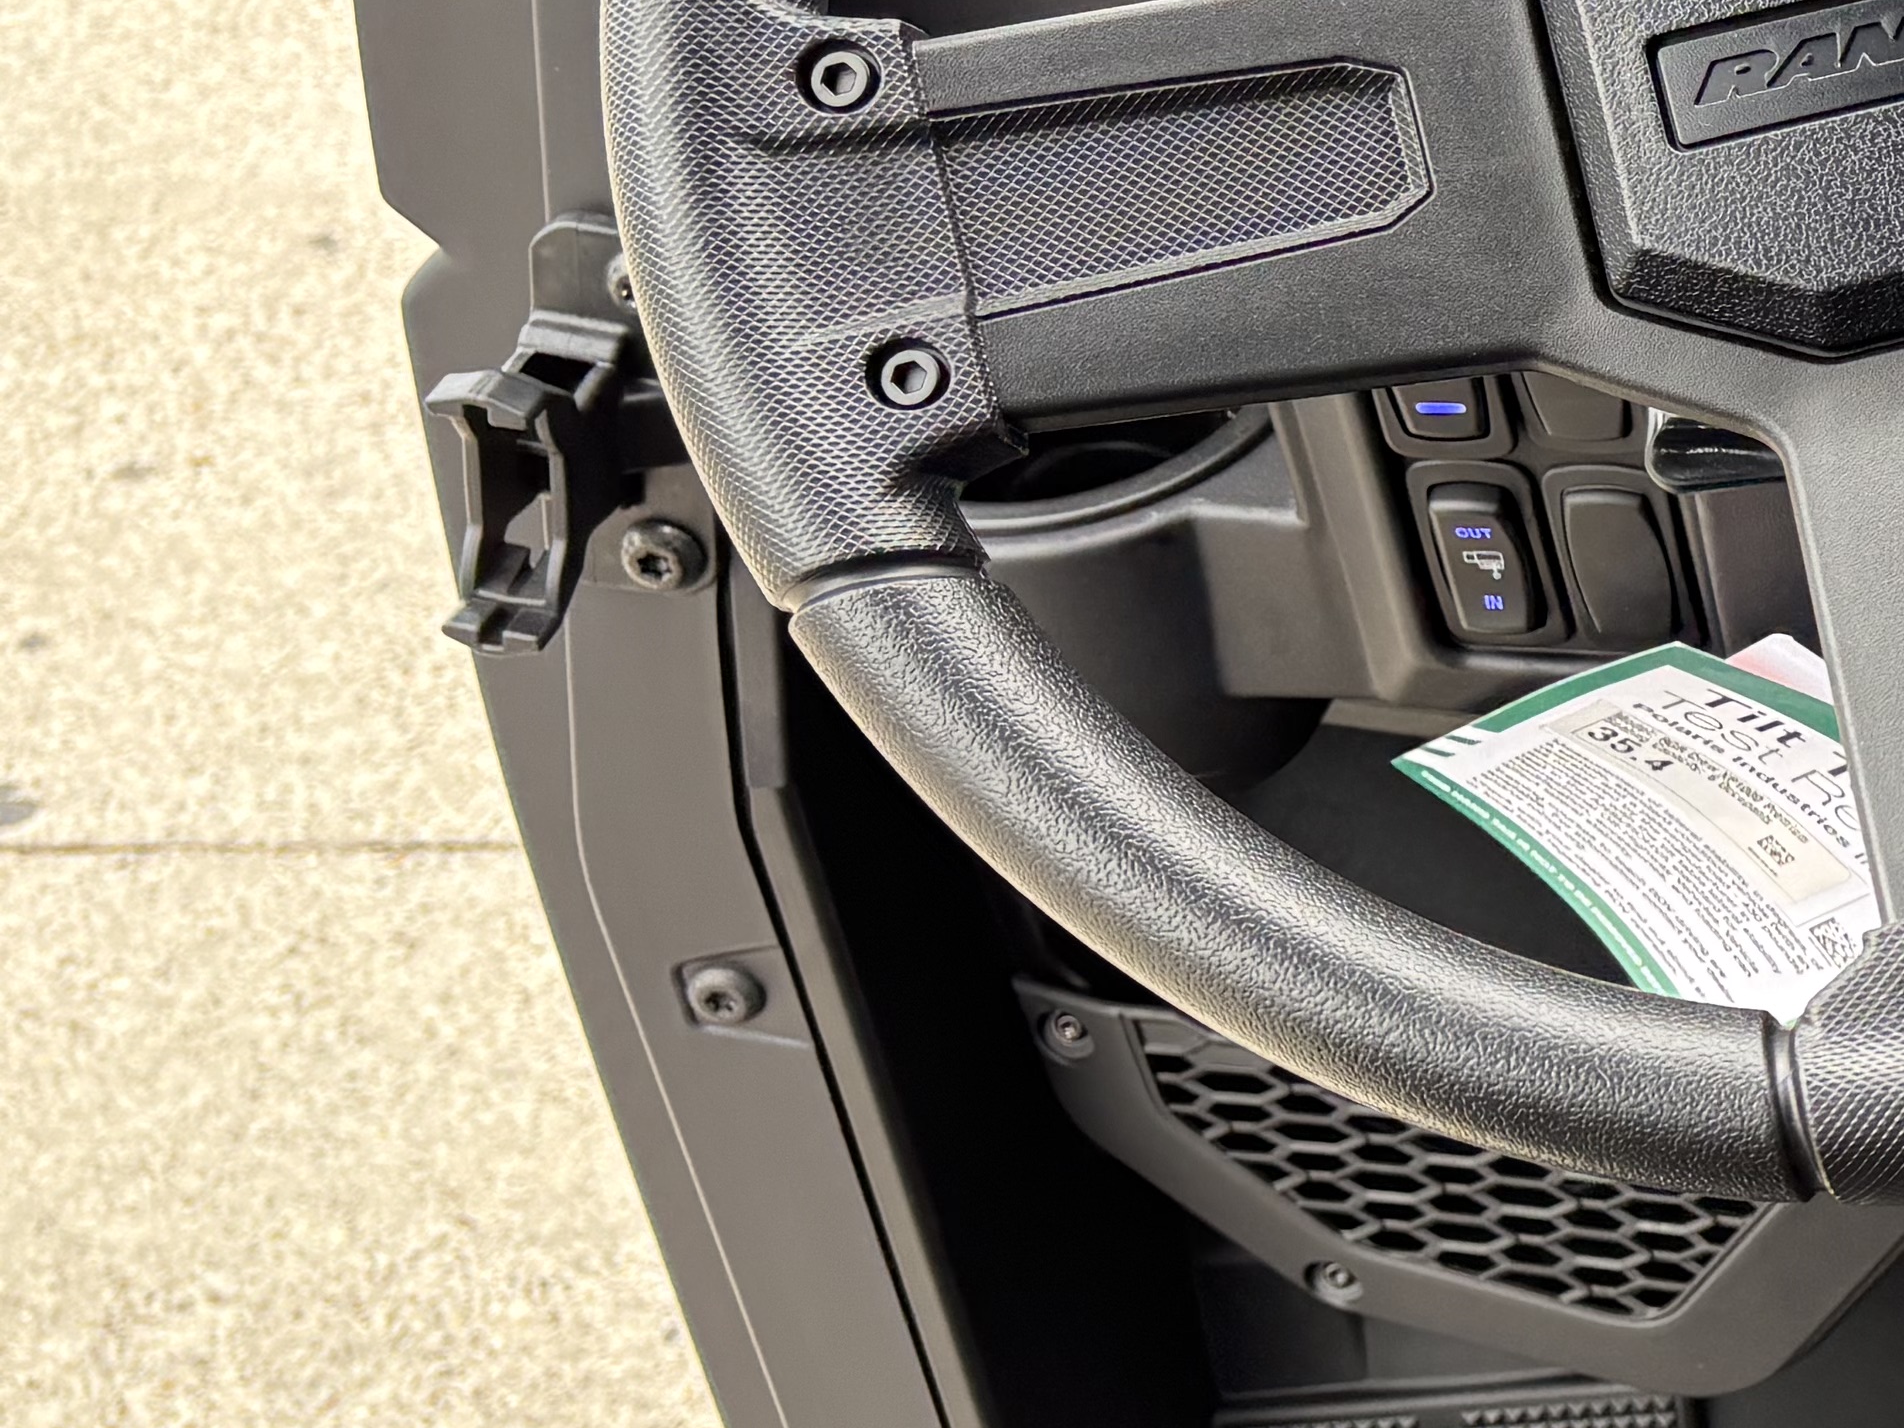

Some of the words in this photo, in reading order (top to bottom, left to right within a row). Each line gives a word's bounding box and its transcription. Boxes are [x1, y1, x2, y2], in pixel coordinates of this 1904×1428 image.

[1455, 527, 1491, 539] OUT
[1484, 594, 1504, 610] IN
[1662, 690, 1783, 765] Test
[1705, 688, 1806, 748] Tilt
[1588, 725, 1675, 772] 35.4
[1633, 703, 1725, 754] Polaris
[1732, 756, 1850, 848] Industries
